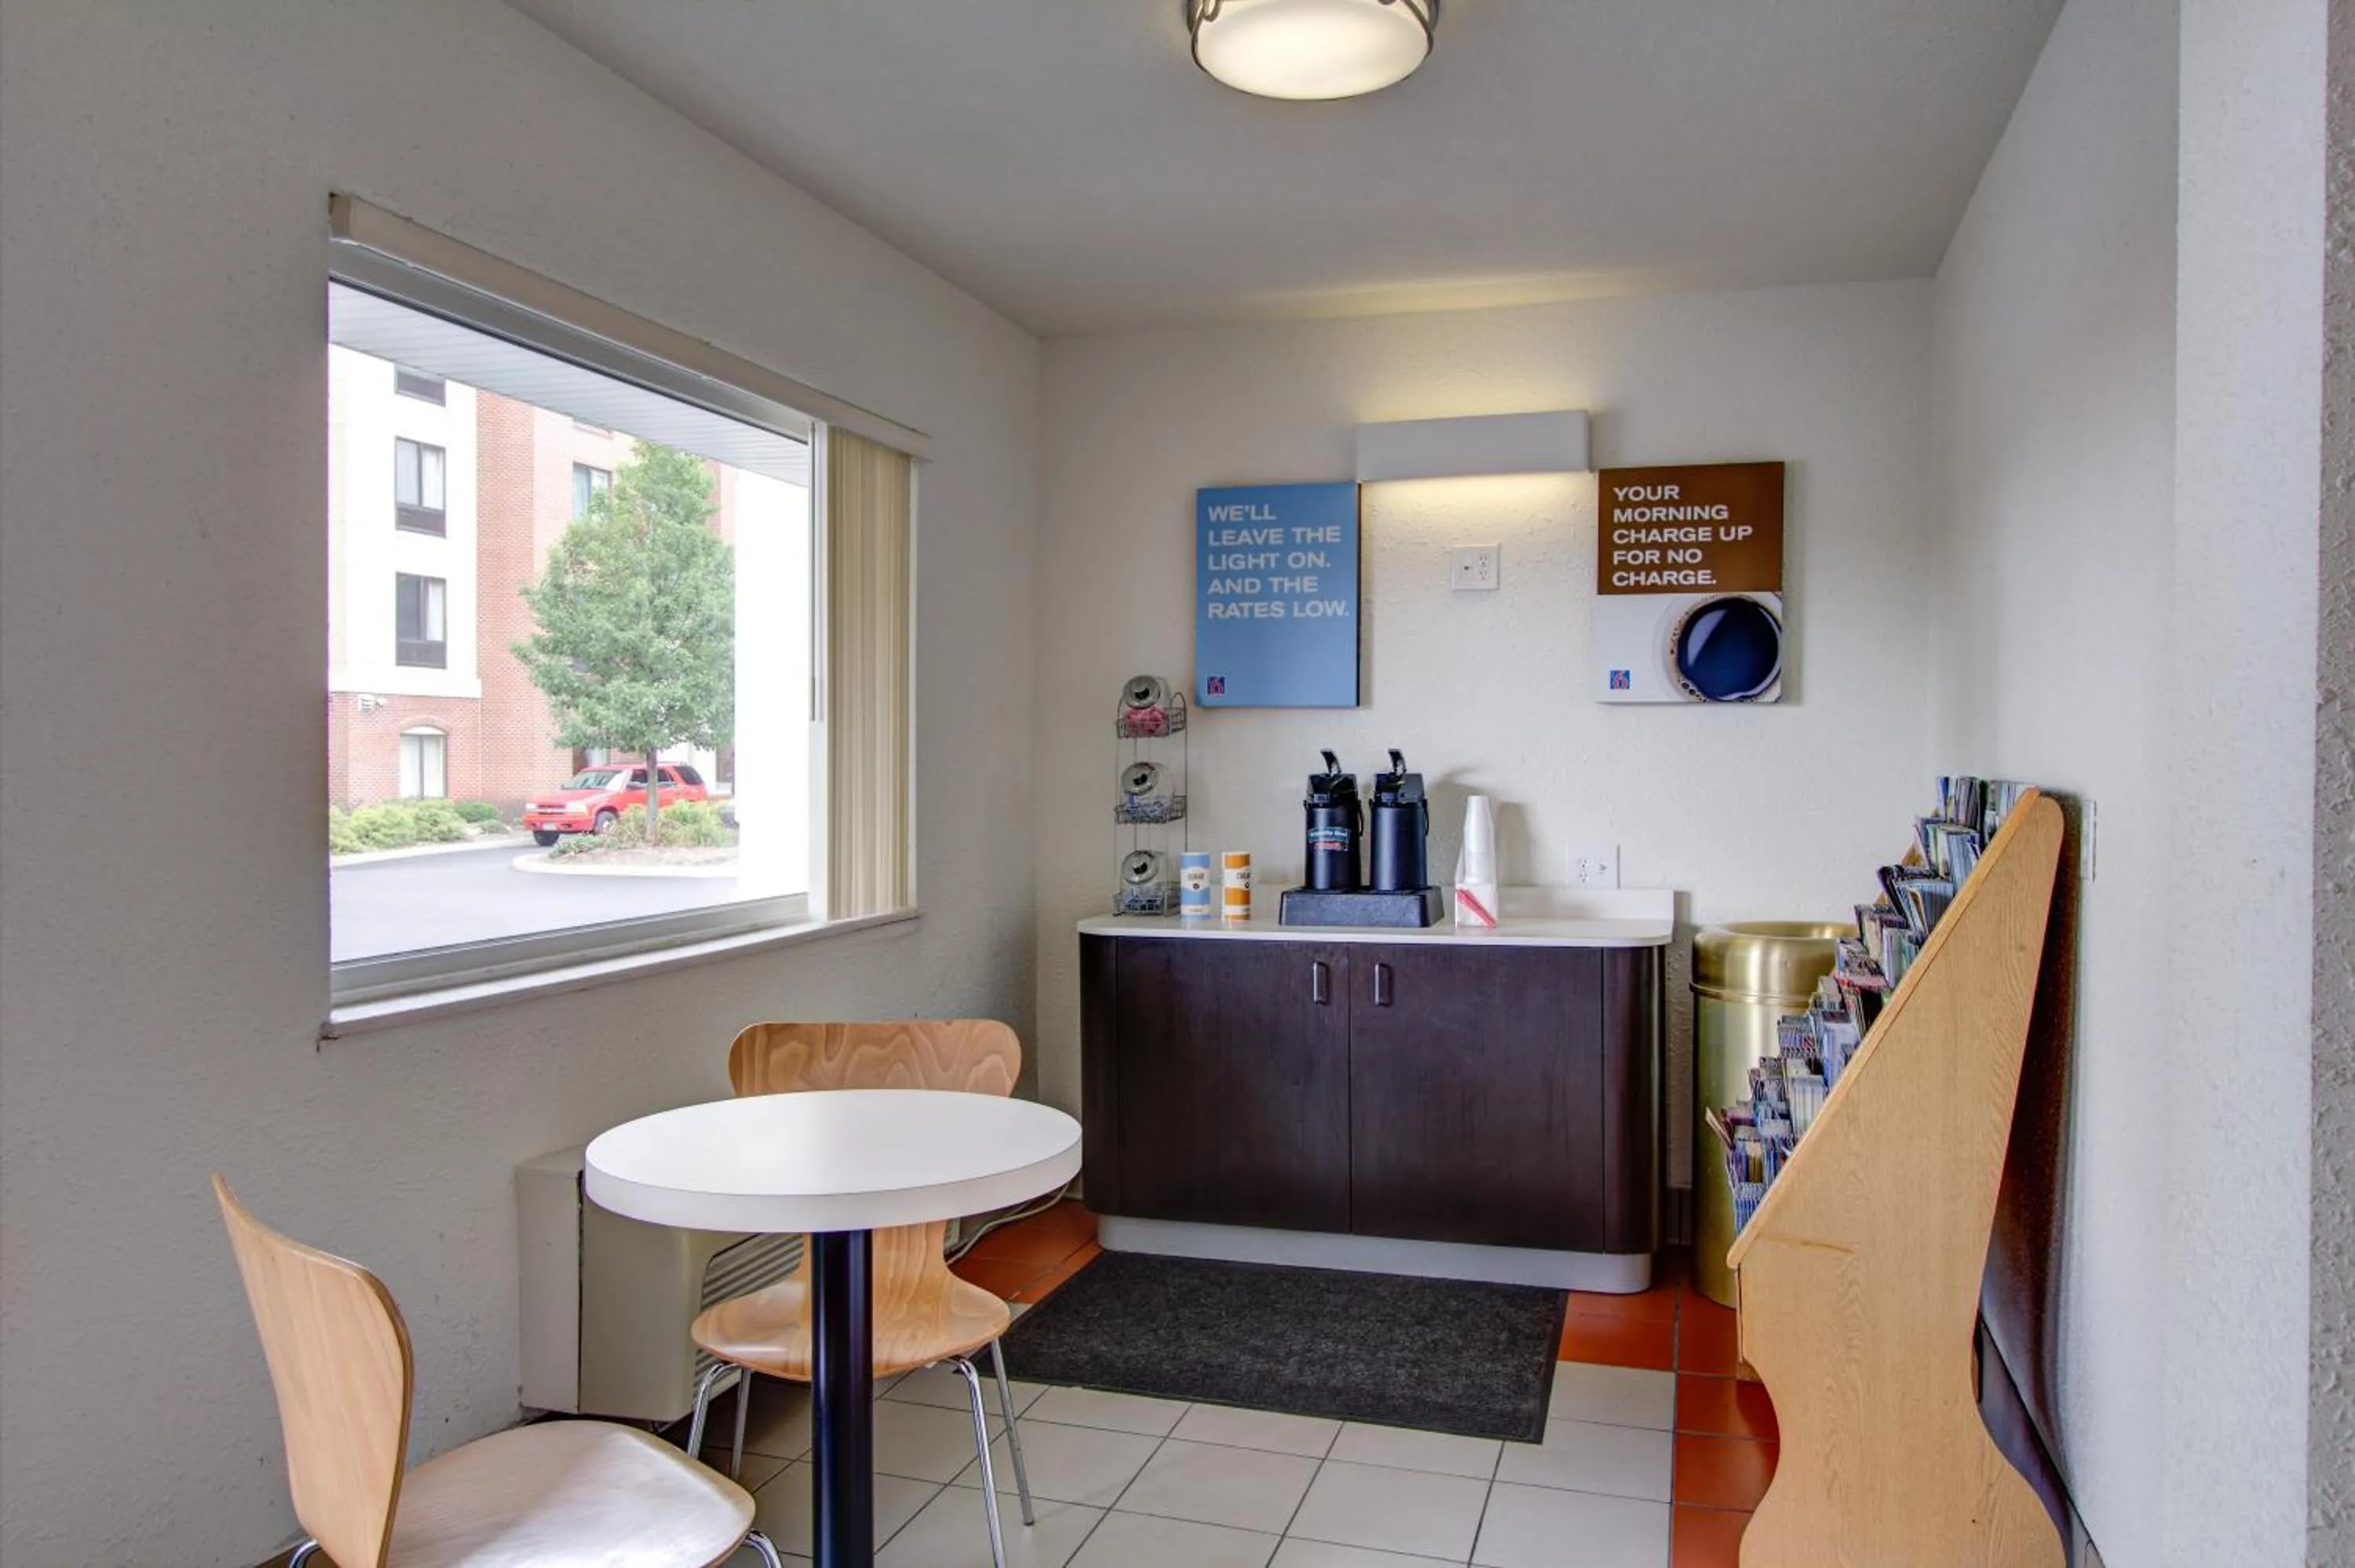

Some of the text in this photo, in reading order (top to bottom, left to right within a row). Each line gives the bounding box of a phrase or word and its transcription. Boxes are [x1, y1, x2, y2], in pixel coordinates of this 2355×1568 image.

[1613, 485, 1681, 501] YOUR
[1208, 505, 1276, 522] WE'LL
[1613, 504, 1729, 523] MORNING
[1208, 526, 1341, 546] LEAVE THE
[1612, 524, 1754, 545] CHARGE UP
[1208, 552, 1331, 571] LIGHT ON.
[1612, 549, 1703, 566] FOR NO
[1207, 577, 1318, 595] AND THE
[1612, 569, 1718, 587] CHARGE.
[1208, 600, 1350, 619] RATES LOW.
